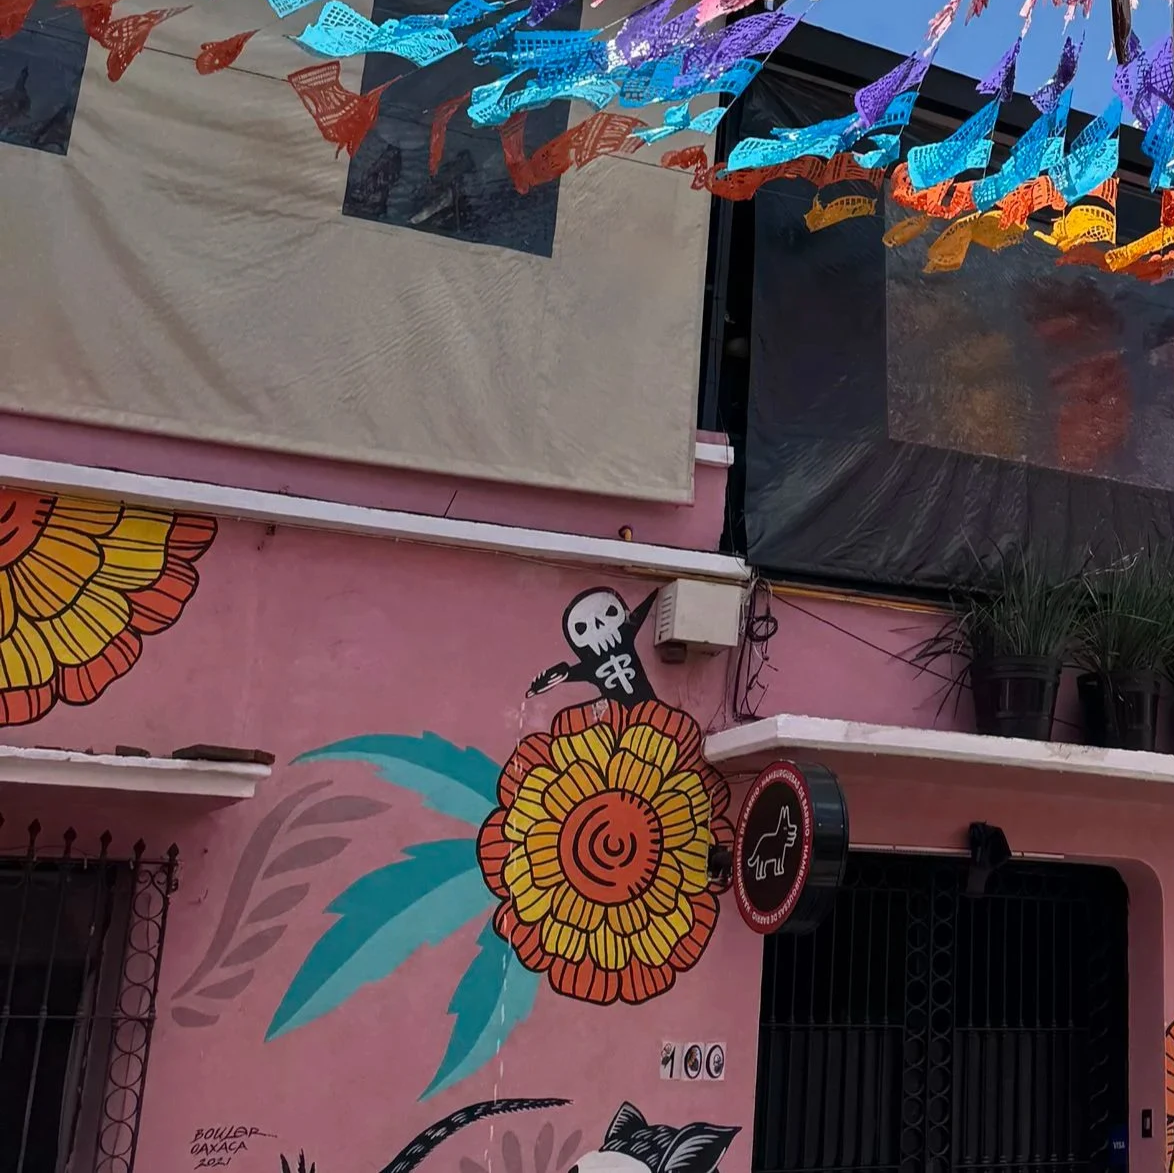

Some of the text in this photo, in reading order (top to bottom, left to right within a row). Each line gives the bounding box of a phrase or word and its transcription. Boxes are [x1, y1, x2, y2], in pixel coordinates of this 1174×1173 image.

[777, 844, 809, 919] HAMBURGUESAS
[662, 1044, 725, 1079] 100
[190, 1141, 248, 1156] OAXACA
[193, 1157, 232, 1170] 2021
